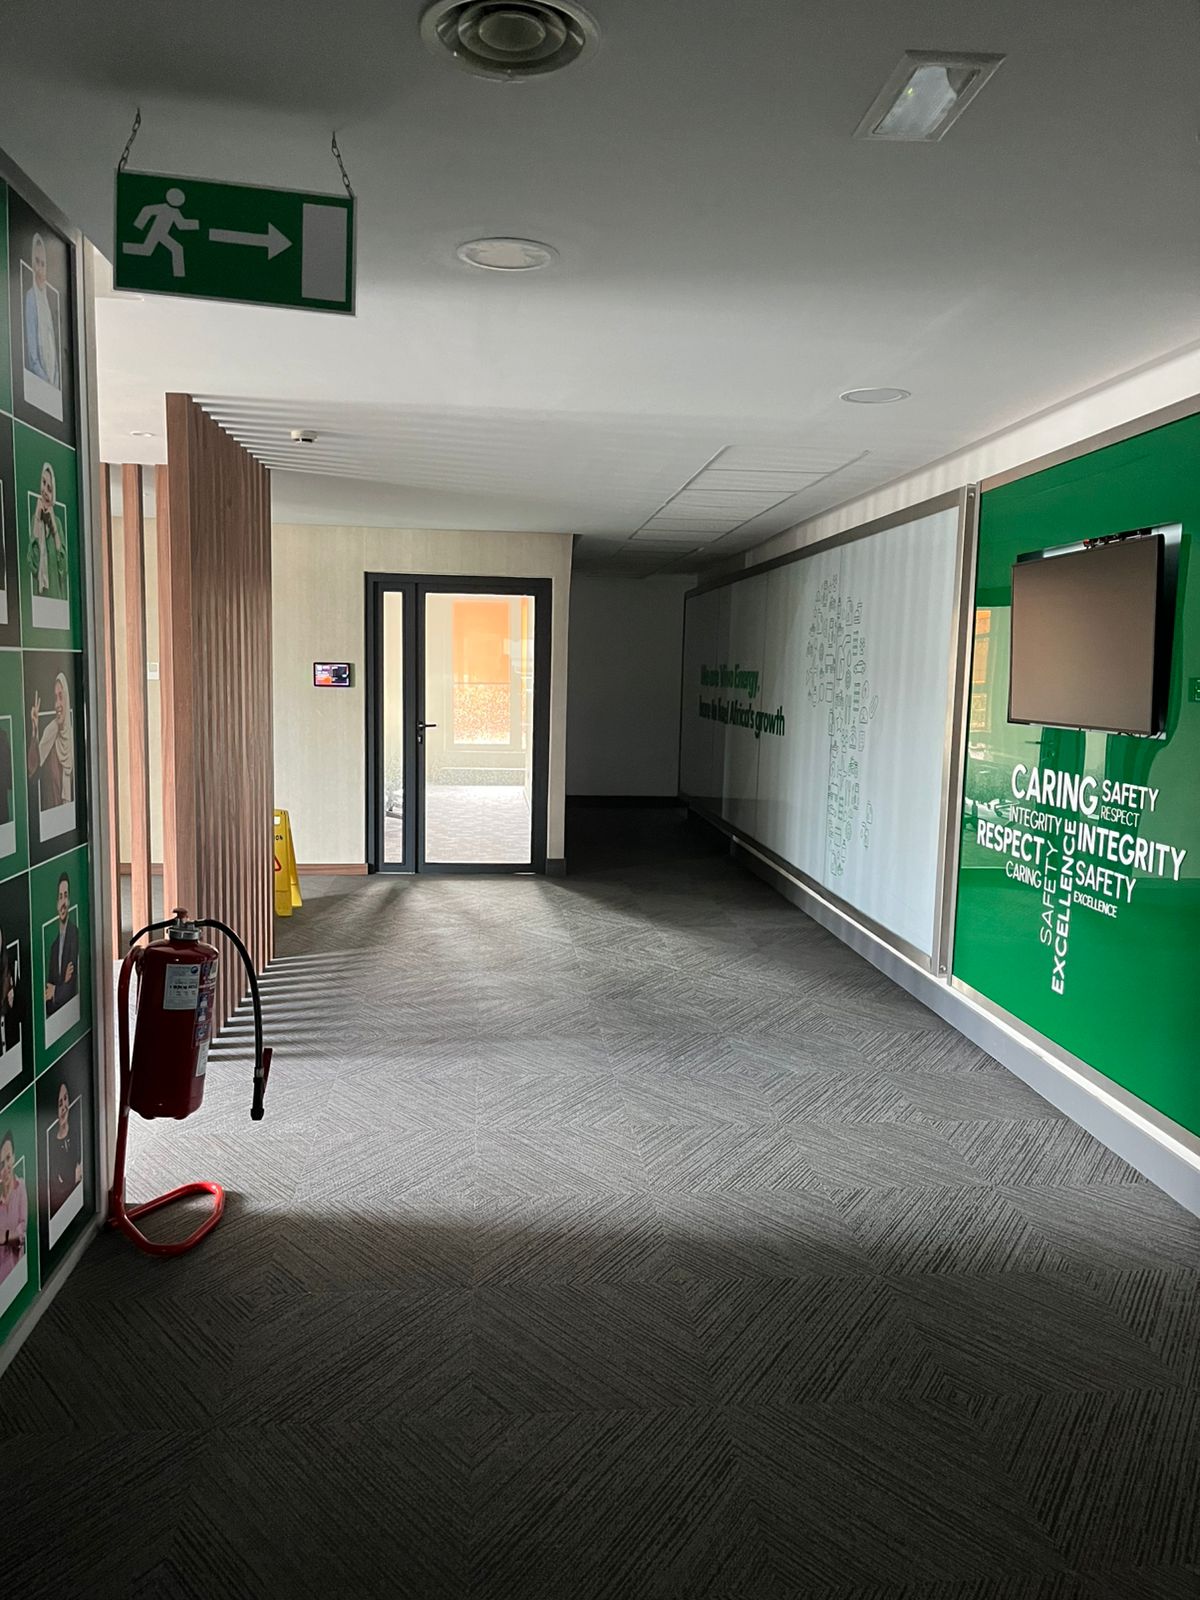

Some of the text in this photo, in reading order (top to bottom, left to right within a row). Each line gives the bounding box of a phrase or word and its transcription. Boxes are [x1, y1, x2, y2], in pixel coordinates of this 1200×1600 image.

[754, 705, 785, 738] growth
[1011, 763, 1098, 816] CARING
[1102, 779, 1160, 812] SAFETY
[1009, 804, 1063, 836] INTEGRITY
[1100, 805, 1140, 828] RESPECT
[976, 819, 1045, 865] RESPECT
[1077, 822, 1187, 881] INTEGRITY
[1005, 860, 1042, 889] CARING
[1040, 839, 1059, 946] SAFETY
[1075, 860, 1137, 904] SAFETY
[1051, 818, 1078, 996] EXCELLENCE
[1073, 890, 1118, 919] EXCELLENCE
